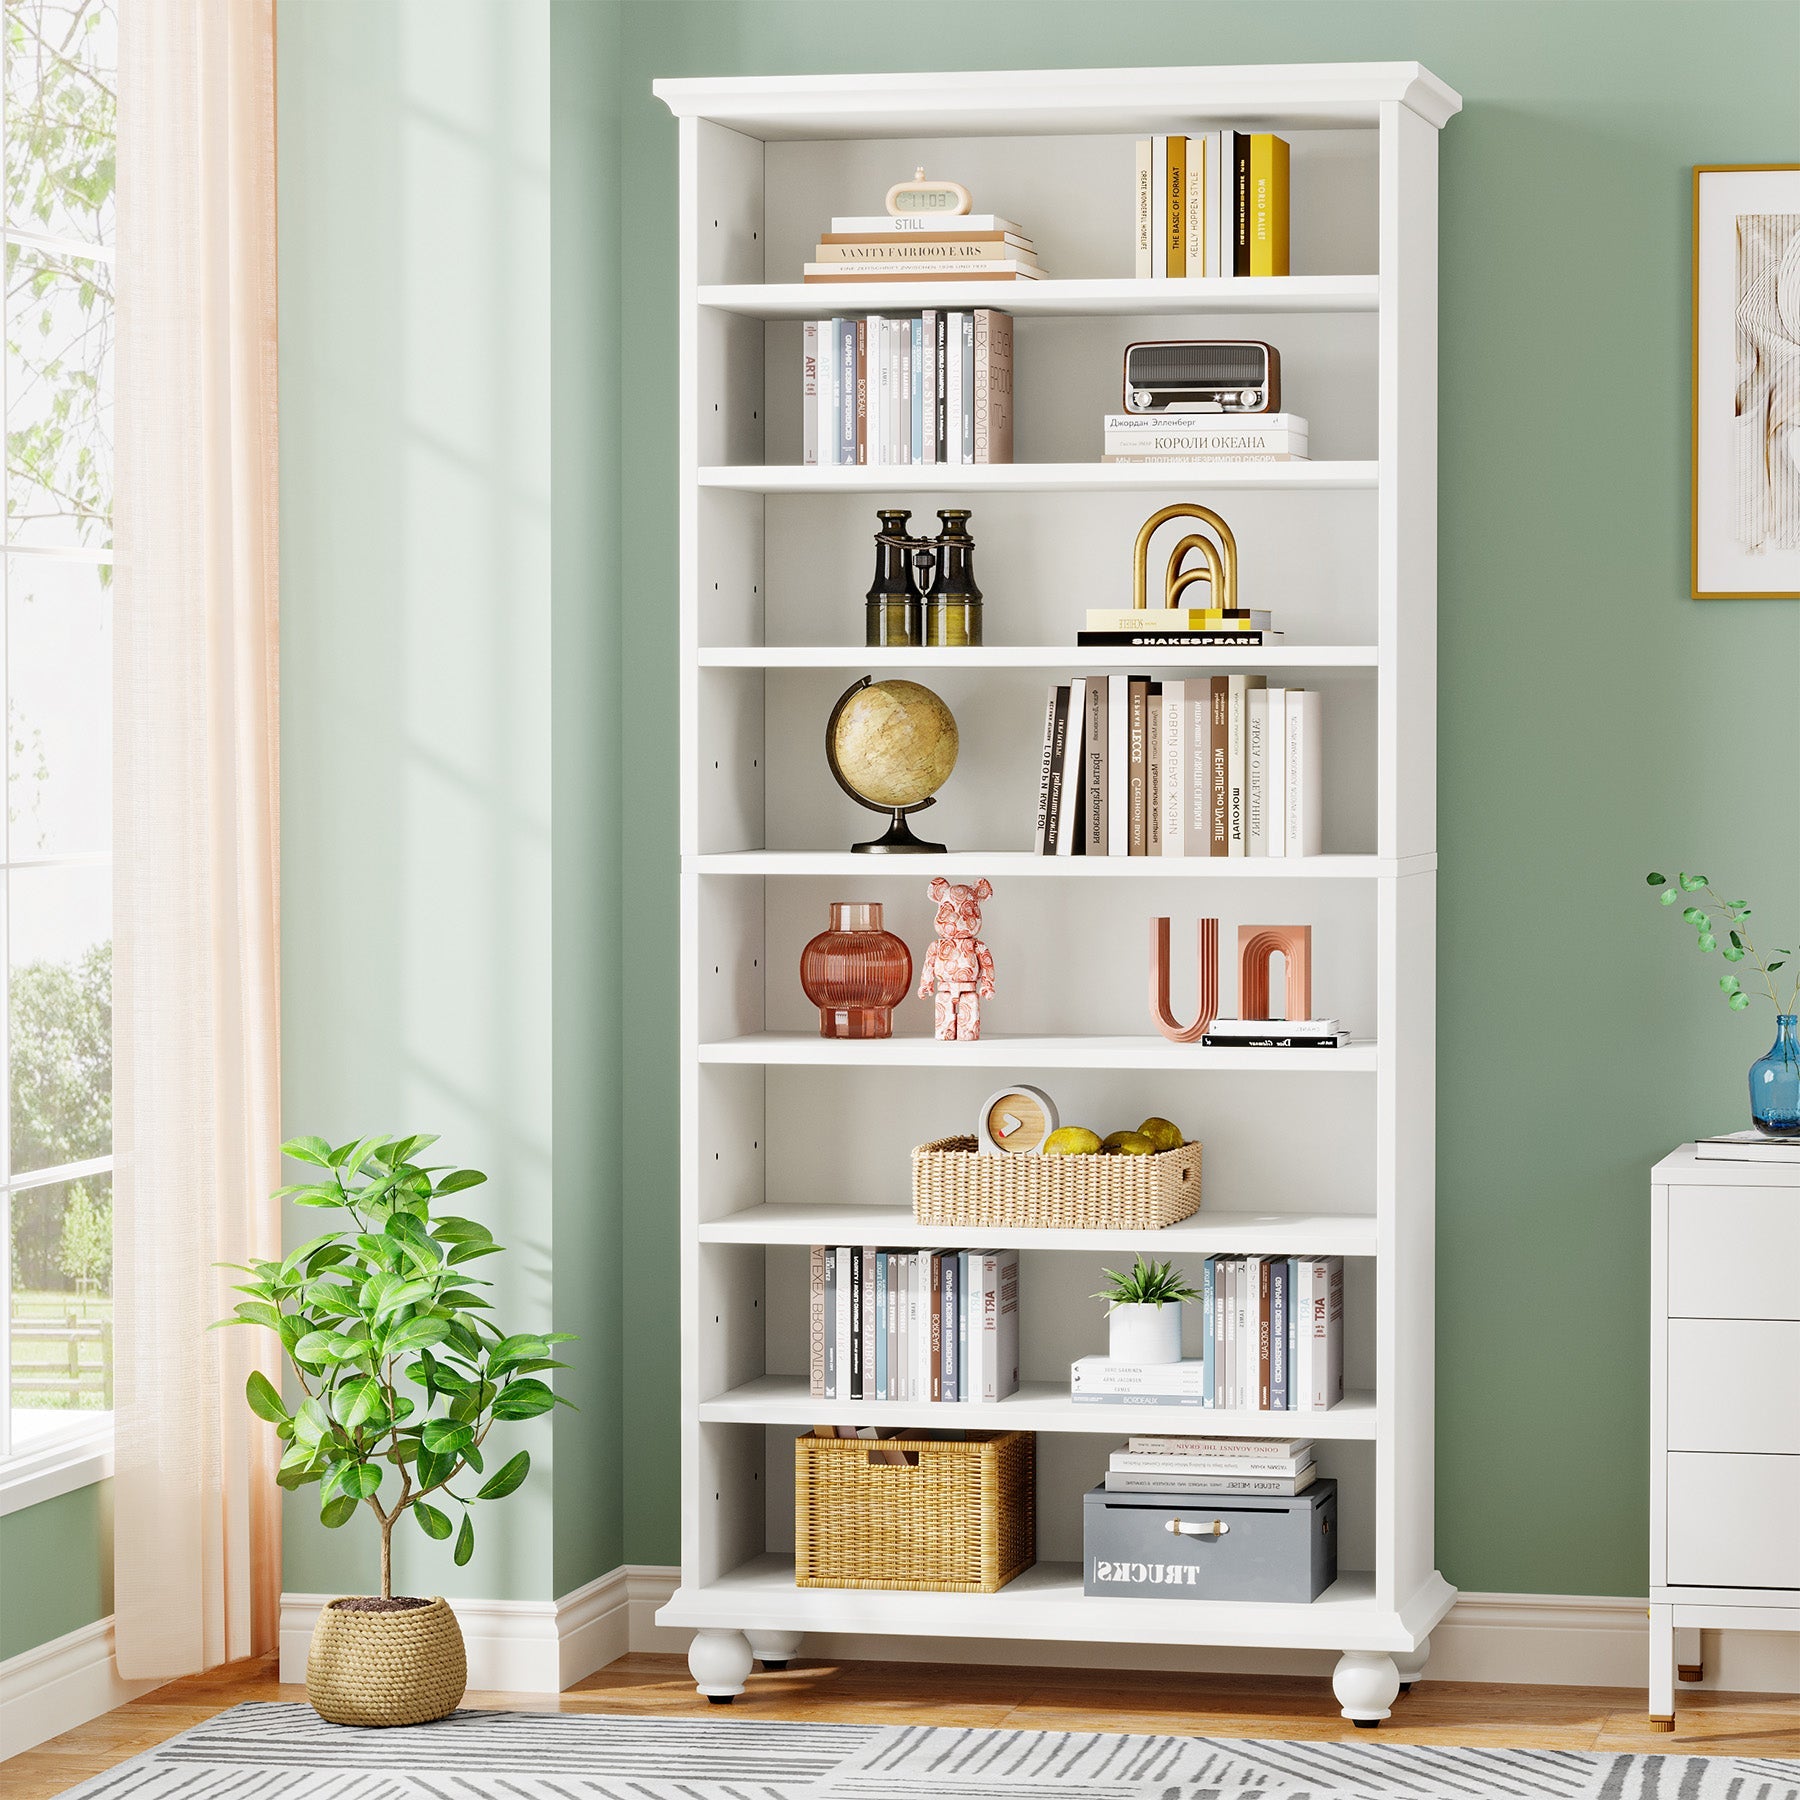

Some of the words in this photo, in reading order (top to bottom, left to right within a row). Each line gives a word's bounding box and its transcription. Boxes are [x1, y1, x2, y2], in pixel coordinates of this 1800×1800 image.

[1172, 166, 1180, 198] FORMAT
[1190, 172, 1199, 195] STYLE
[1258, 178, 1266, 208] WORLD
[1172, 200, 1180, 210] OF
[1190, 199, 1199, 231] HOPPEN
[895, 219, 924, 230] STILL
[1172, 212, 1180, 234] BASIC
[1258, 211, 1266, 241] BALLET
[1172, 235, 1180, 250] THE
[1190, 233, 1199, 258] KELLY
[975, 313, 988, 367] ALEXEY
[806, 356, 816, 379] ART
[924, 347, 934, 379] BOOK
[858, 379, 866, 418] BORDEAUX
[924, 391, 934, 446] SYMBOLS
[975, 370, 988, 457] BRODOVITCH
[1110, 419, 1149, 428] Джордан
[1151, 418, 1196, 428] Элленберг
[1155, 437, 1208, 449] КОРОЛИ
[1211, 436, 1266, 448] ОКЕАНА
